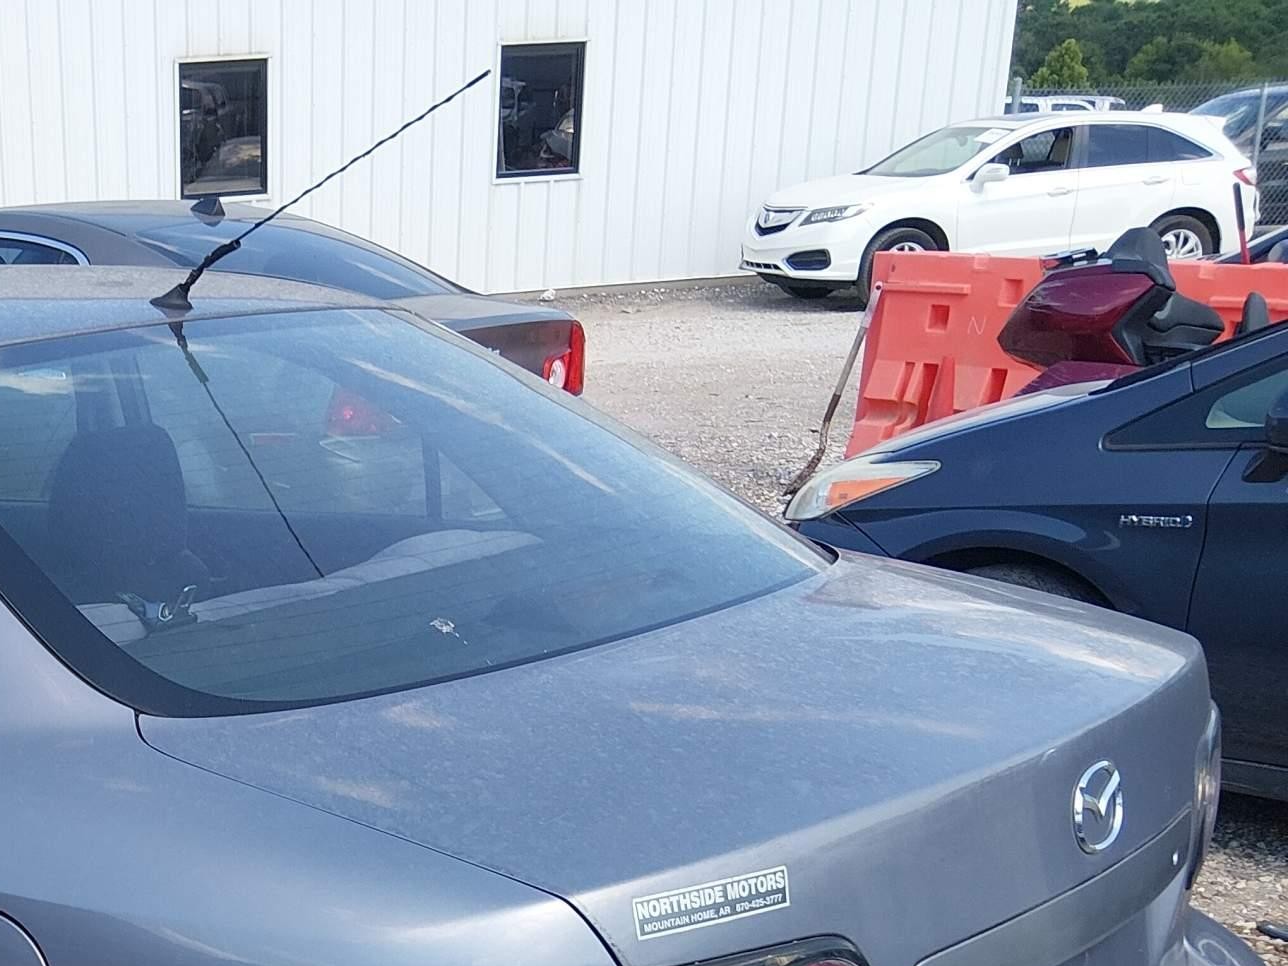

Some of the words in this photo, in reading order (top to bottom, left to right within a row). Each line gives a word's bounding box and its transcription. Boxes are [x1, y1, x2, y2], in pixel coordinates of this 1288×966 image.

[1118, 514, 1182, 528] HYBRID
[636, 884, 725, 920] NORTHSIDE
[726, 871, 786, 900] MOTORS
[643, 914, 690, 933] MOUNTAIN
[690, 906, 719, 923] HOME,
[718, 904, 732, 917] AR
